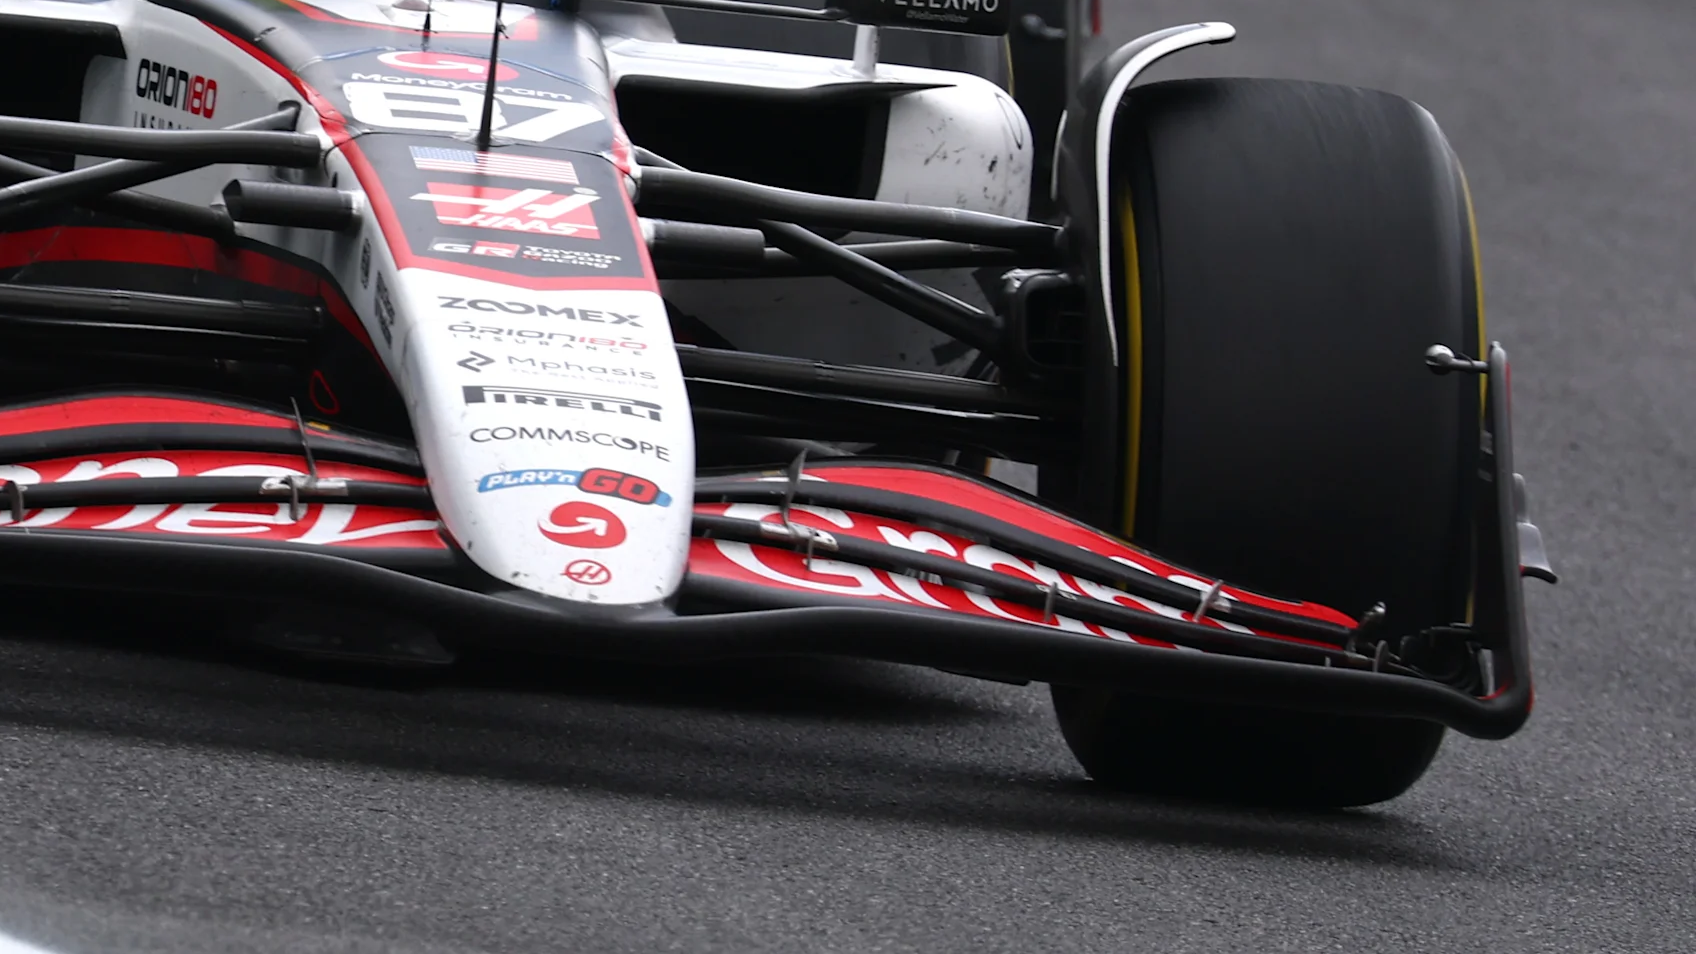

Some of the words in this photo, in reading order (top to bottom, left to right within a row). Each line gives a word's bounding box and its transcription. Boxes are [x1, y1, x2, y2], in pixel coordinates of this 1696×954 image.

[136, 58, 217, 119] ORION180
[342, 81, 606, 143] 87
[437, 213, 598, 236] HAAS
[432, 242, 515, 259] GR
[437, 295, 645, 328] ZOOMEX
[452, 333, 643, 356] INSURANCE
[507, 355, 656, 381] Mphasis
[461, 385, 663, 422] PIRELLI
[469, 426, 671, 463] COMMSCOPE
[581, 471, 656, 503] GO
